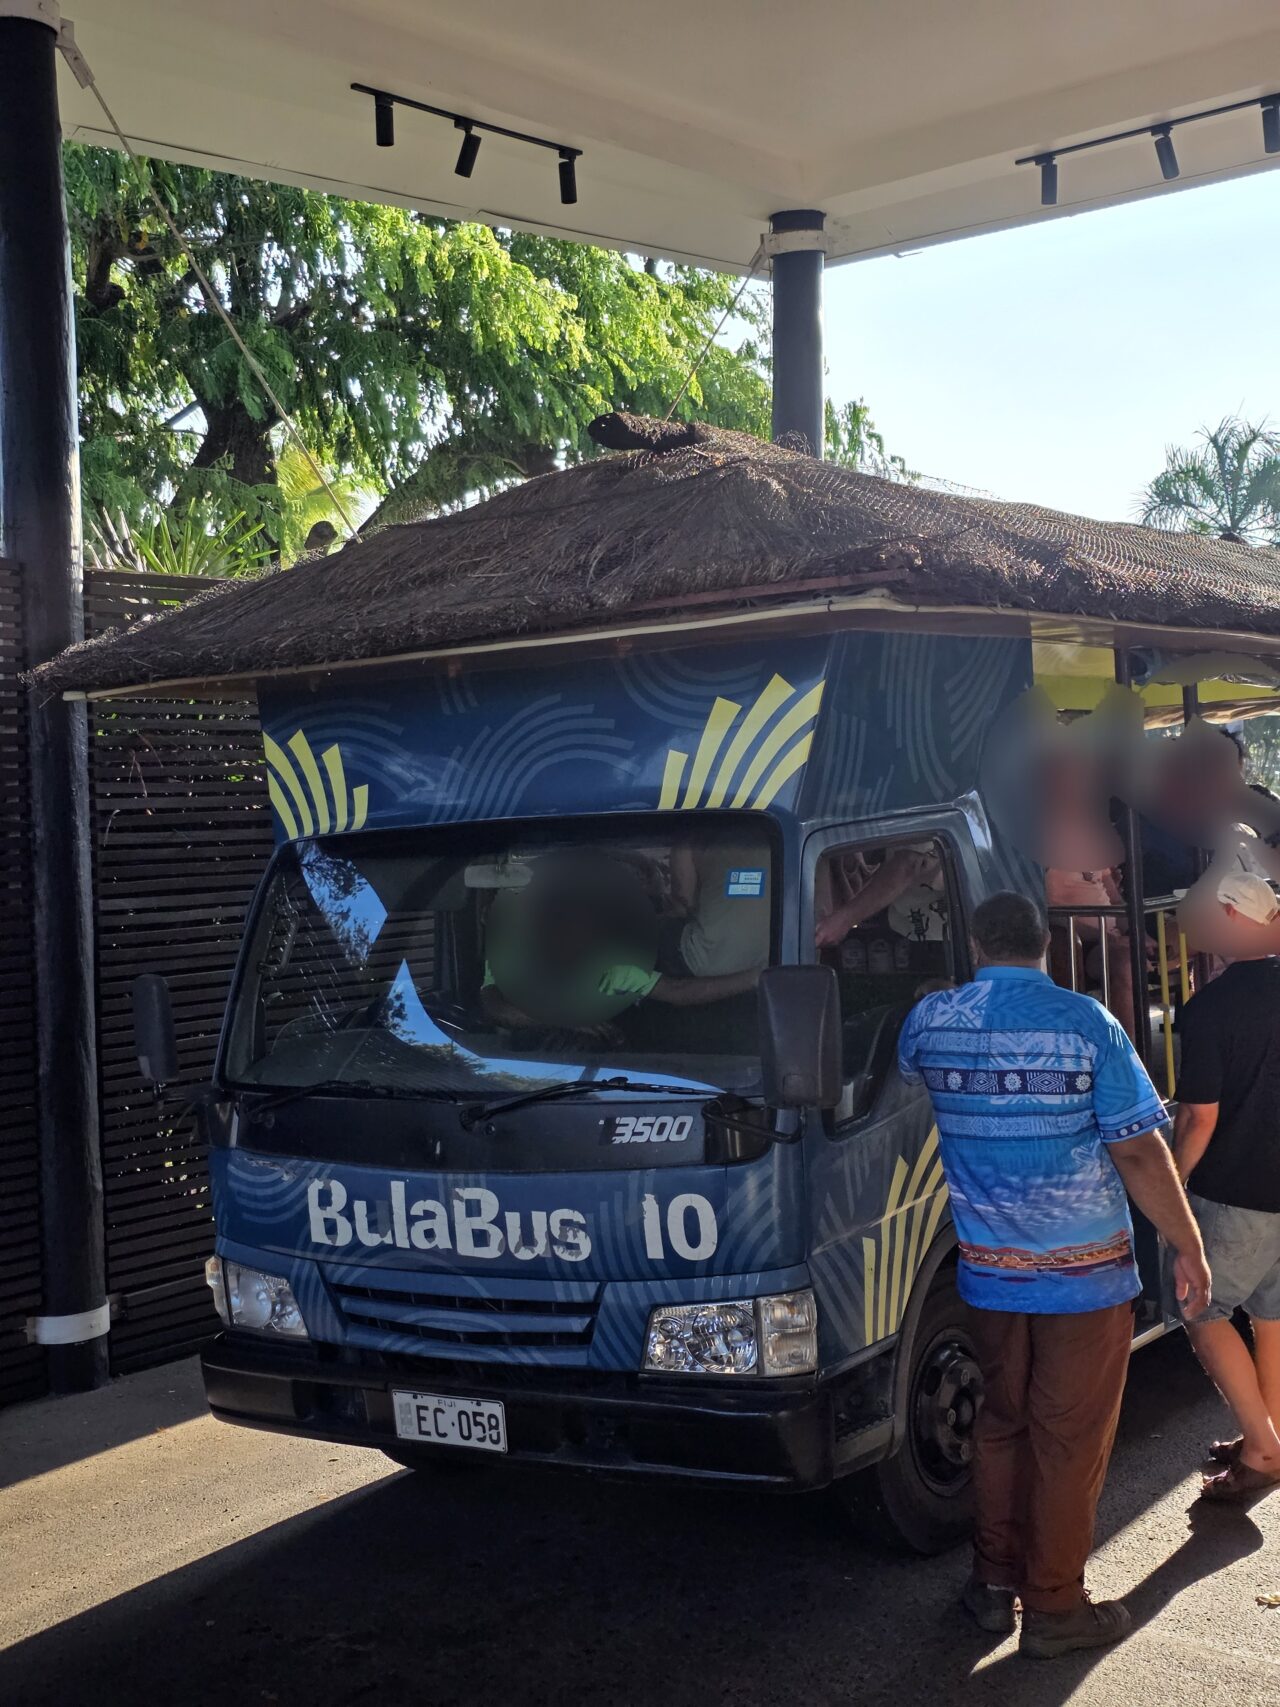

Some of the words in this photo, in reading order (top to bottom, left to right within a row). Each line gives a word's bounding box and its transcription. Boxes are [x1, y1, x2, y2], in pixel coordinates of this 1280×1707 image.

[612, 1116, 694, 1144] 3500
[308, 1178, 592, 1262] BulaBus
[642, 1193, 718, 1261] 10
